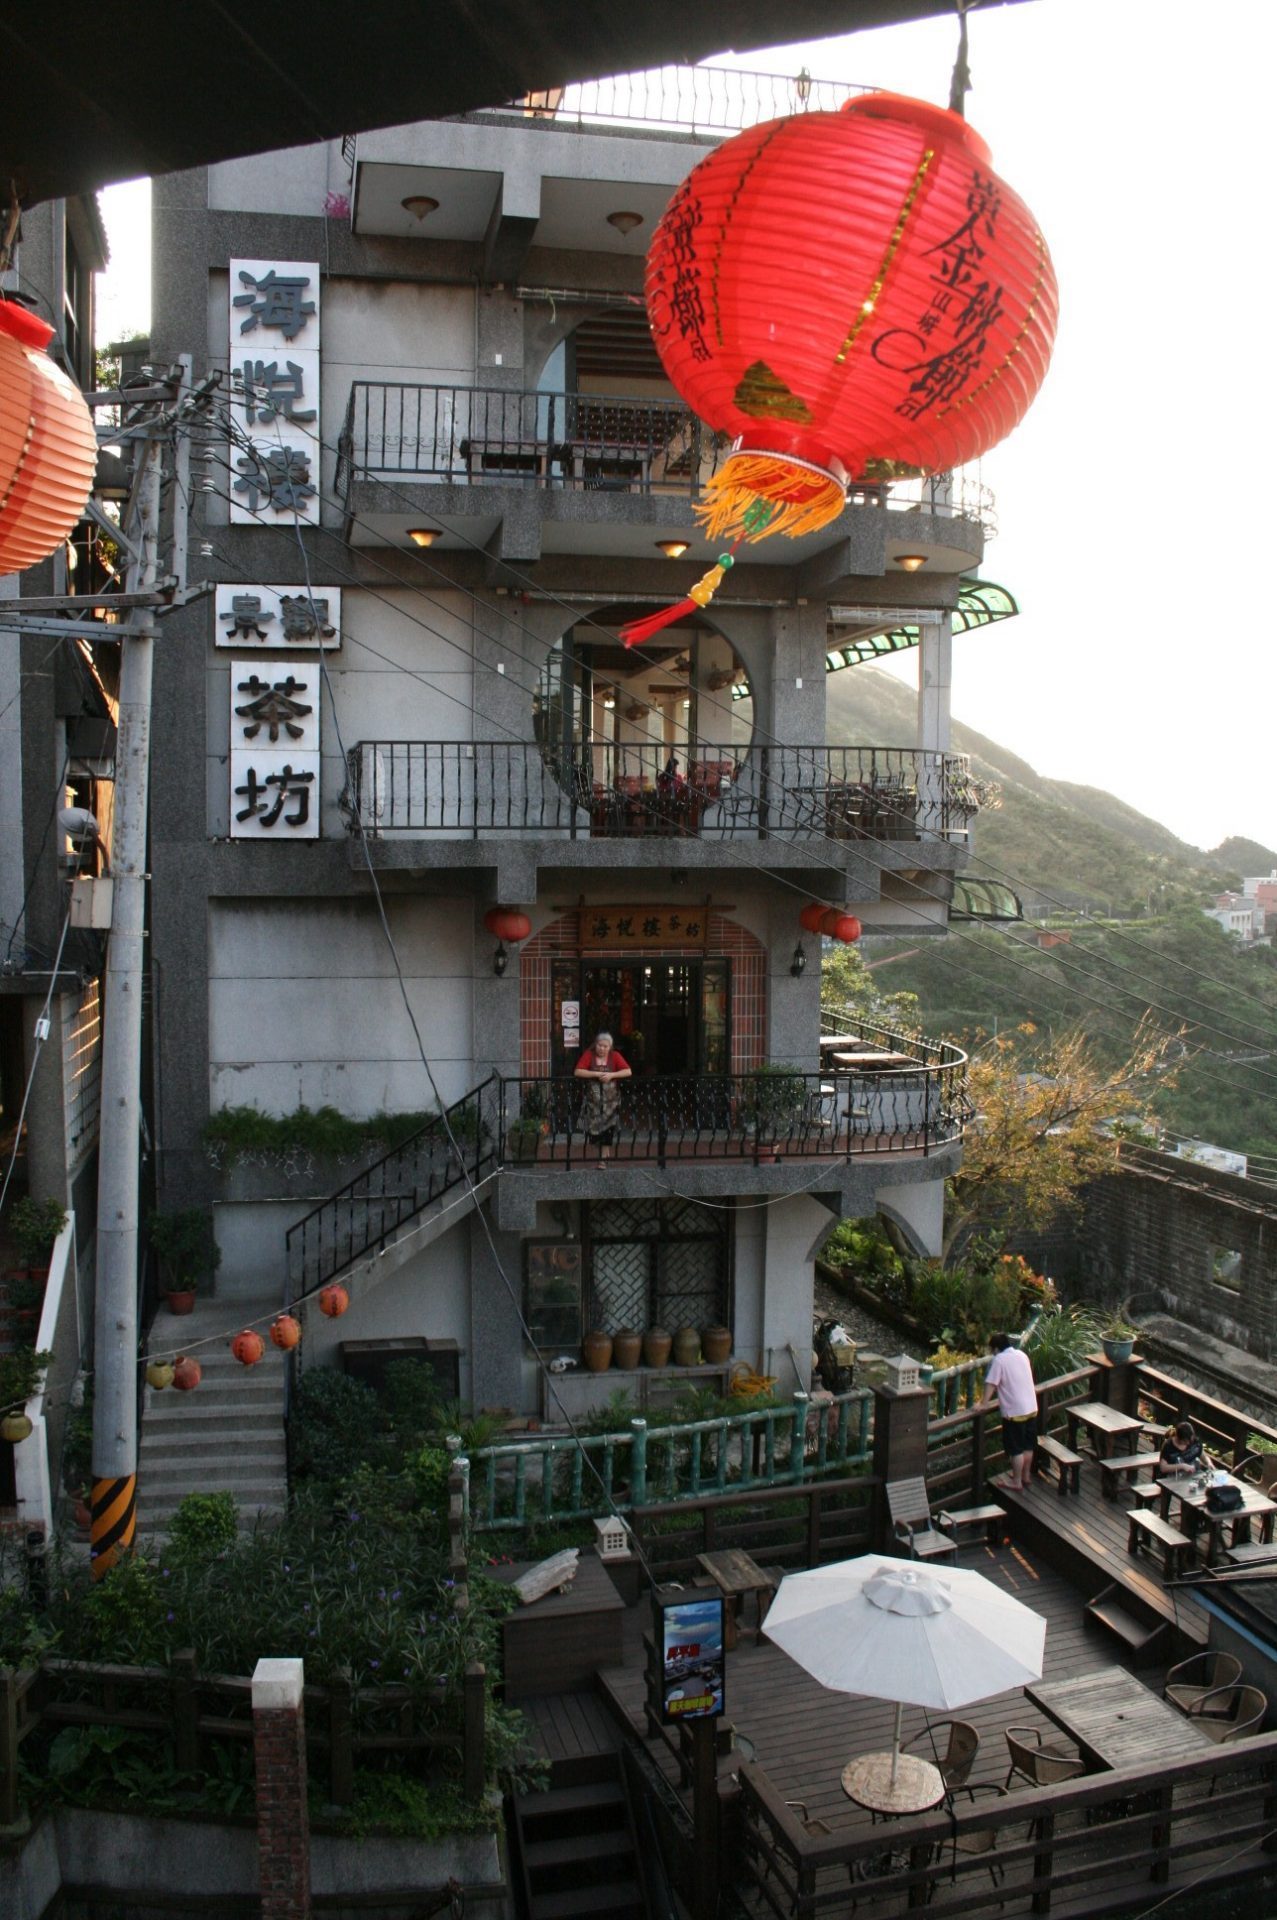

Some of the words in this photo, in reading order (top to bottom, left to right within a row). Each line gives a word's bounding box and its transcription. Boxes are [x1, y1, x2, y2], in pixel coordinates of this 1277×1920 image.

[233, 269, 317, 514] 海悅樓
[219, 593, 336, 641] 景觀
[235, 675, 315, 827] 茶坊
